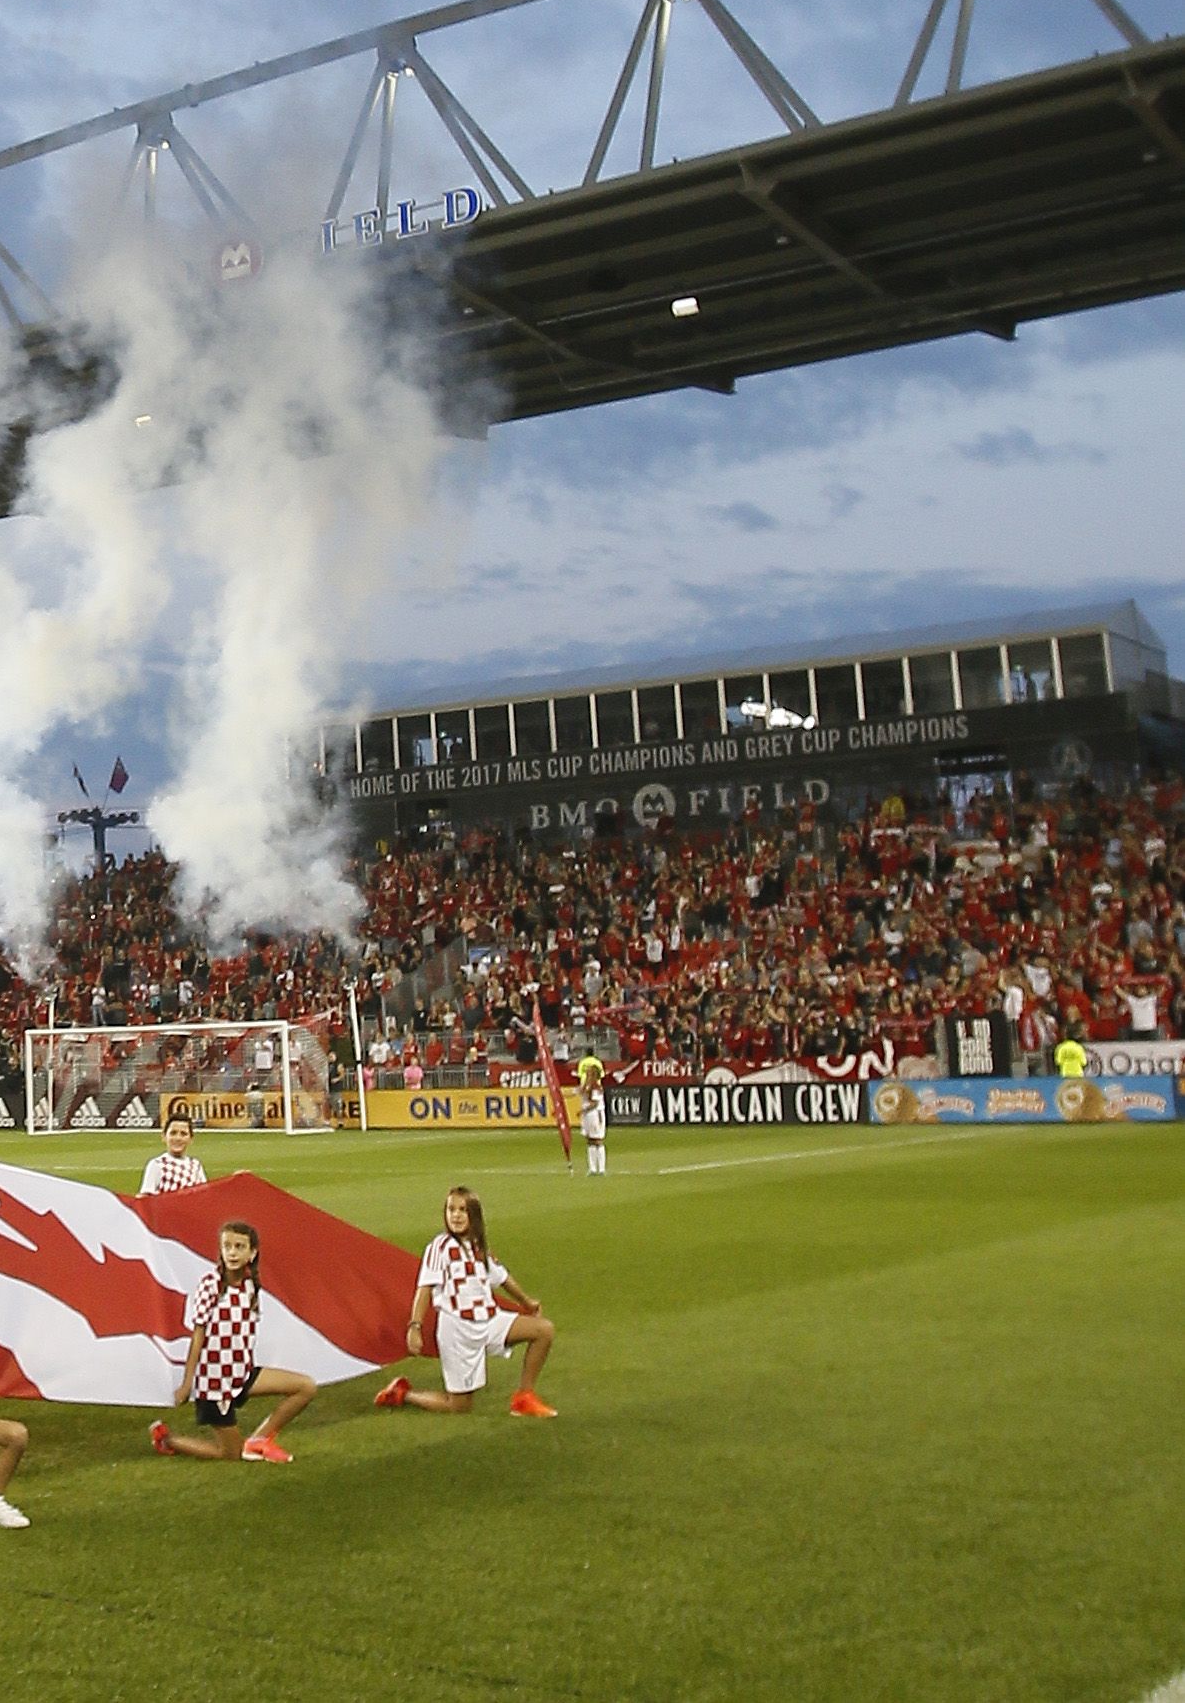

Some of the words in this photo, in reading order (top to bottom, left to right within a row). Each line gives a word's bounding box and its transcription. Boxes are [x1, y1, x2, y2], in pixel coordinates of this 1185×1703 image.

[320, 185, 482, 255] IELD
[350, 774, 395, 798] HOME
[400, 772, 420, 793] OF
[426, 768, 457, 790] THE
[462, 763, 502, 788] 2017
[507, 759, 542, 783] MLS
[547, 756, 583, 779] CUP
[589, 741, 695, 776] CHAMPIONS
[701, 739, 738, 764] AND
[745, 733, 794, 759] GREY
[800, 729, 840, 754] CUP
[847, 715, 969, 749] CHAMPIONS
[688, 779, 830, 817] FIELD
[168, 1096, 285, 1120] Contineal
[410, 1096, 452, 1120] ON
[458, 1100, 479, 1114] the
[485, 1095, 547, 1119] RUN
[650, 1085, 783, 1124] AMERICAN
[795, 1083, 860, 1123] CREW
[70, 1116, 107, 1128] adidas
[116, 1116, 154, 1128] adidas
